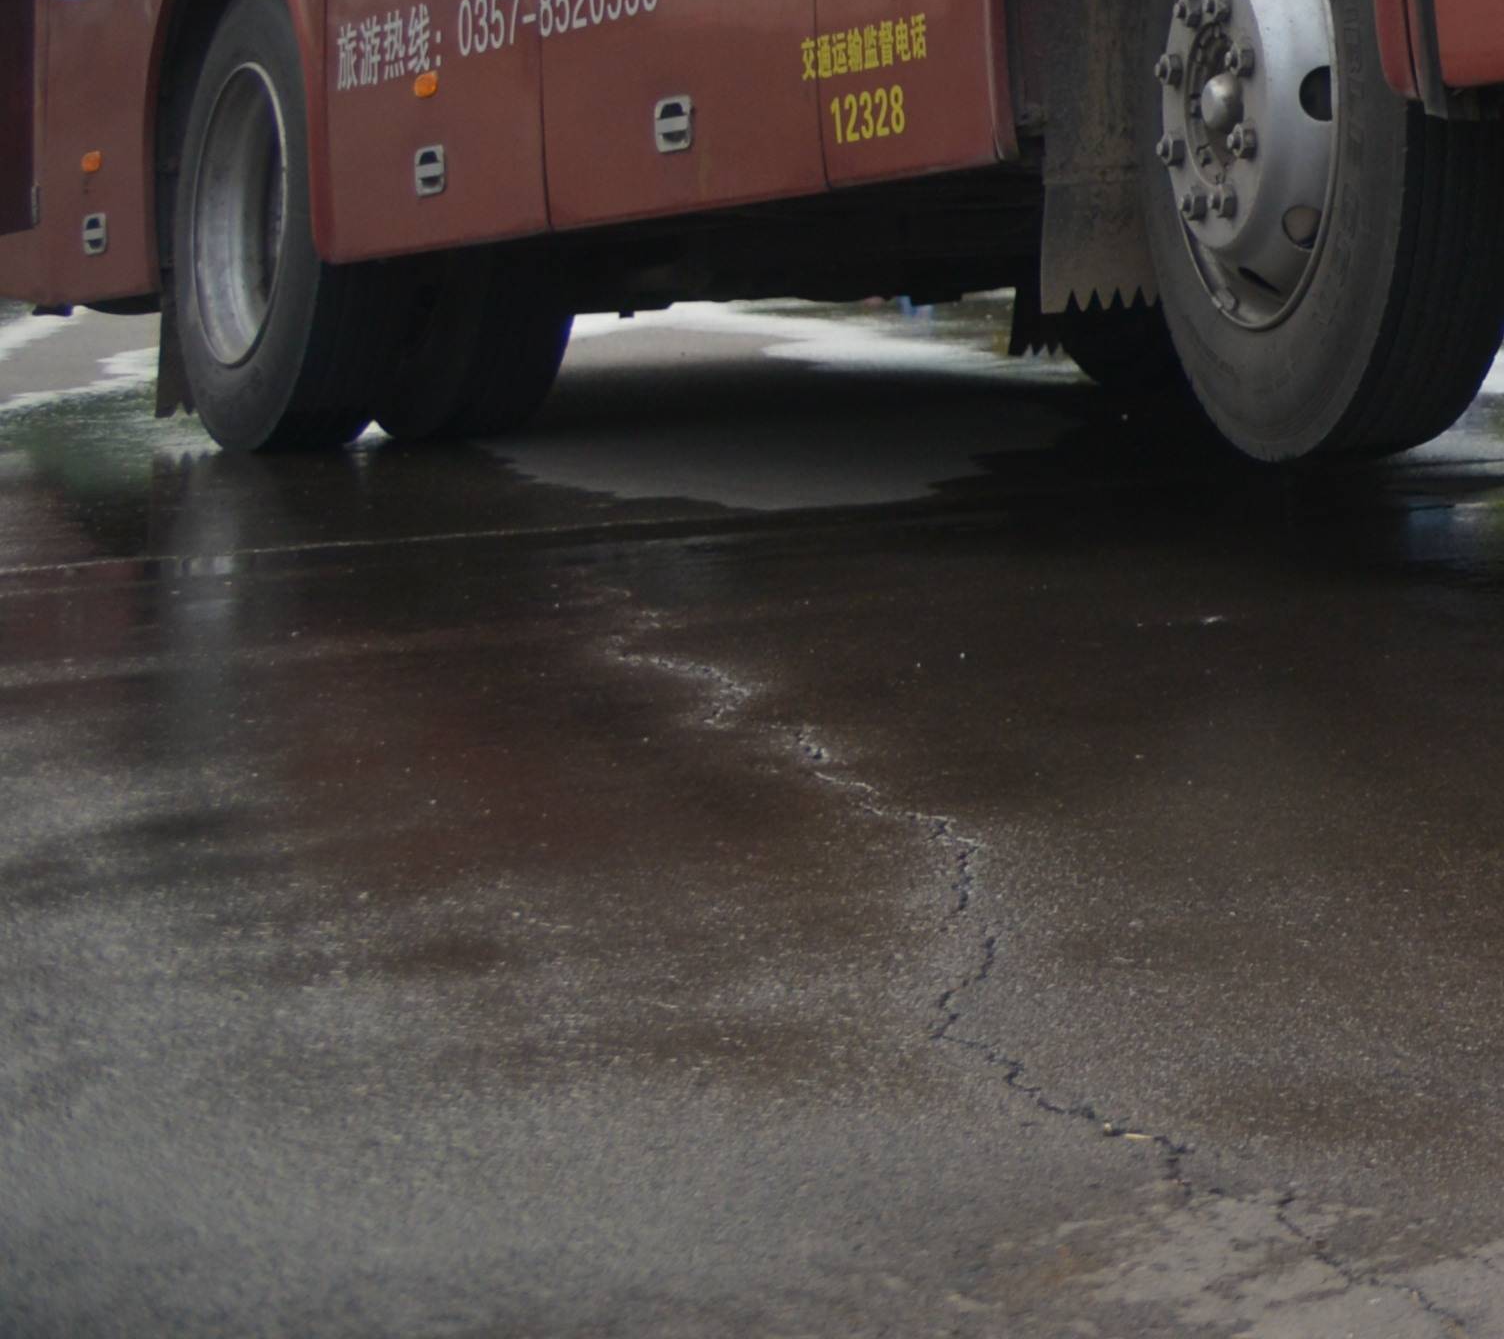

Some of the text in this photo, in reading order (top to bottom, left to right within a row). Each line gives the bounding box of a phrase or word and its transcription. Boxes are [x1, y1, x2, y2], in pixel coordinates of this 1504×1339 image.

[801, 13, 927, 81] 交通运输监督电话
[830, 84, 906, 144] 12328
